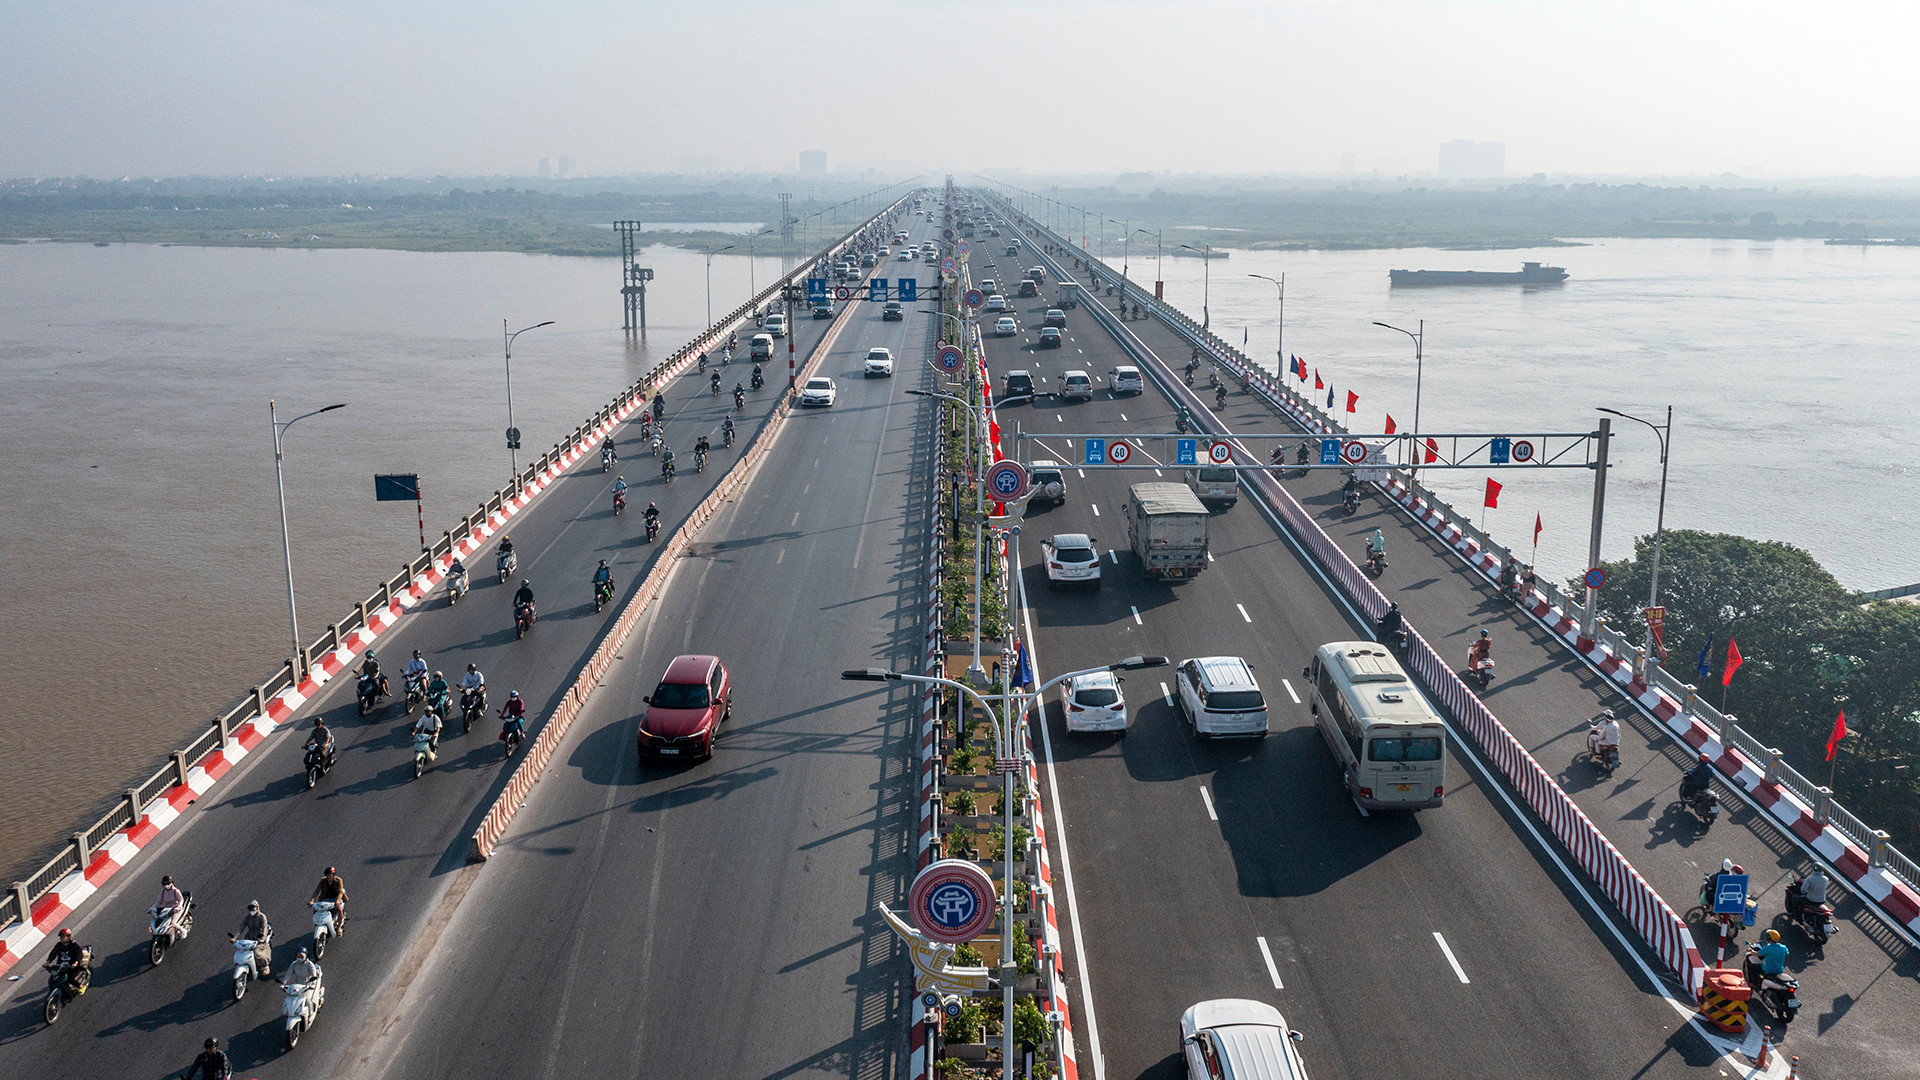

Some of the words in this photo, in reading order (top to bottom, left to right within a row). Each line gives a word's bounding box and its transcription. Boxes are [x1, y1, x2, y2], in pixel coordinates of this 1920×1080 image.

[1114, 448, 1125, 458] 60
[1215, 447, 1226, 458] 60
[1350, 447, 1361, 457] 60
[1517, 446, 1528, 456] 40
